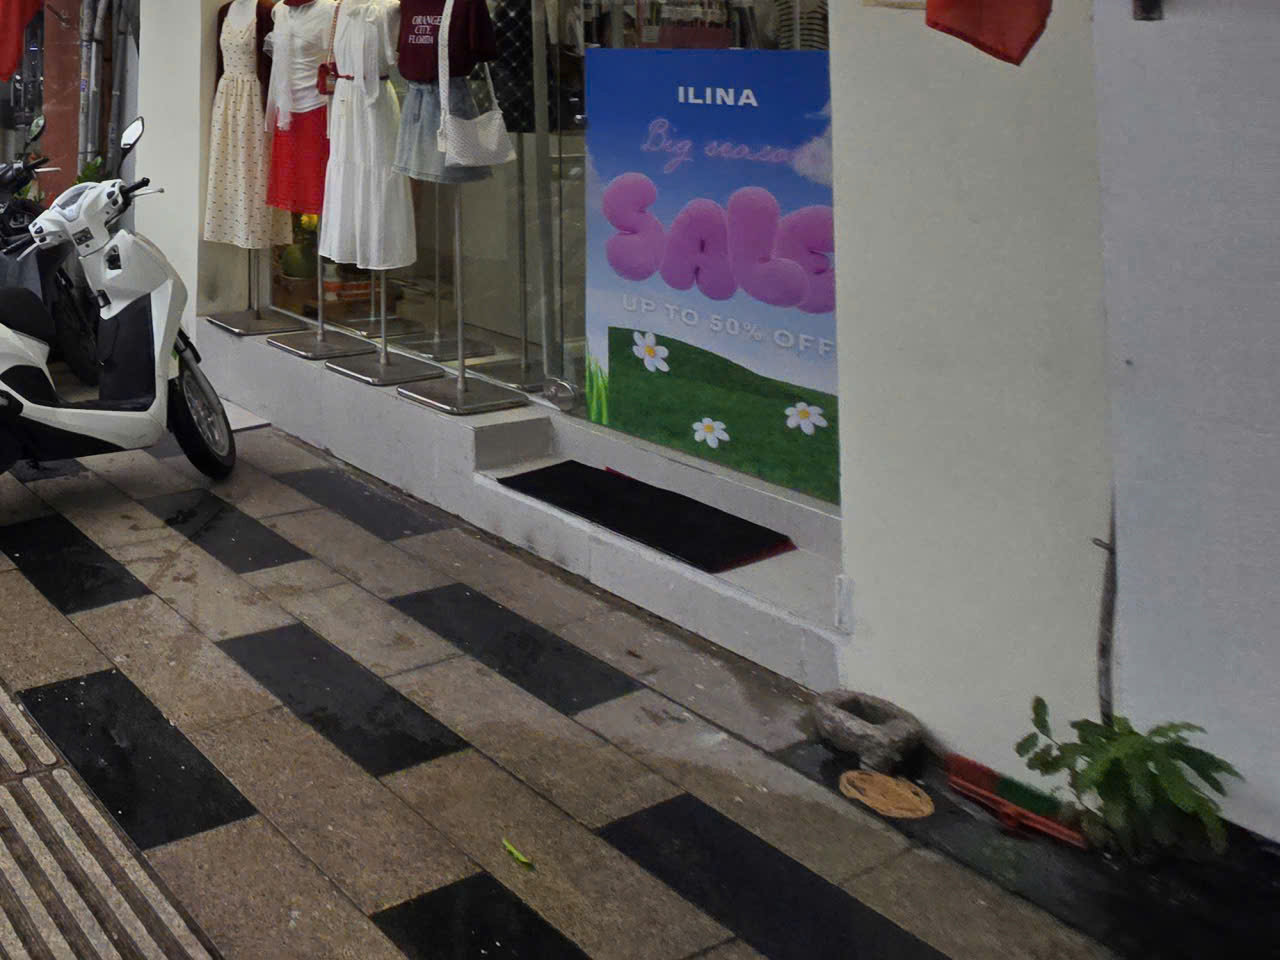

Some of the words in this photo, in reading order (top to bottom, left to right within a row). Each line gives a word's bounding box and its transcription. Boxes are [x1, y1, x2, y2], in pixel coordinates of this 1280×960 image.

[412, 15, 442, 25] ORANGE
[408, 34, 434, 44] FLORIDA
[678, 86, 759, 107] ILINA
[641, 118, 694, 174] Big
[623, 294, 657, 314] UP
[664, 302, 700, 327] TO
[710, 313, 763, 341] 50%
[773, 329, 835, 355] OFF
